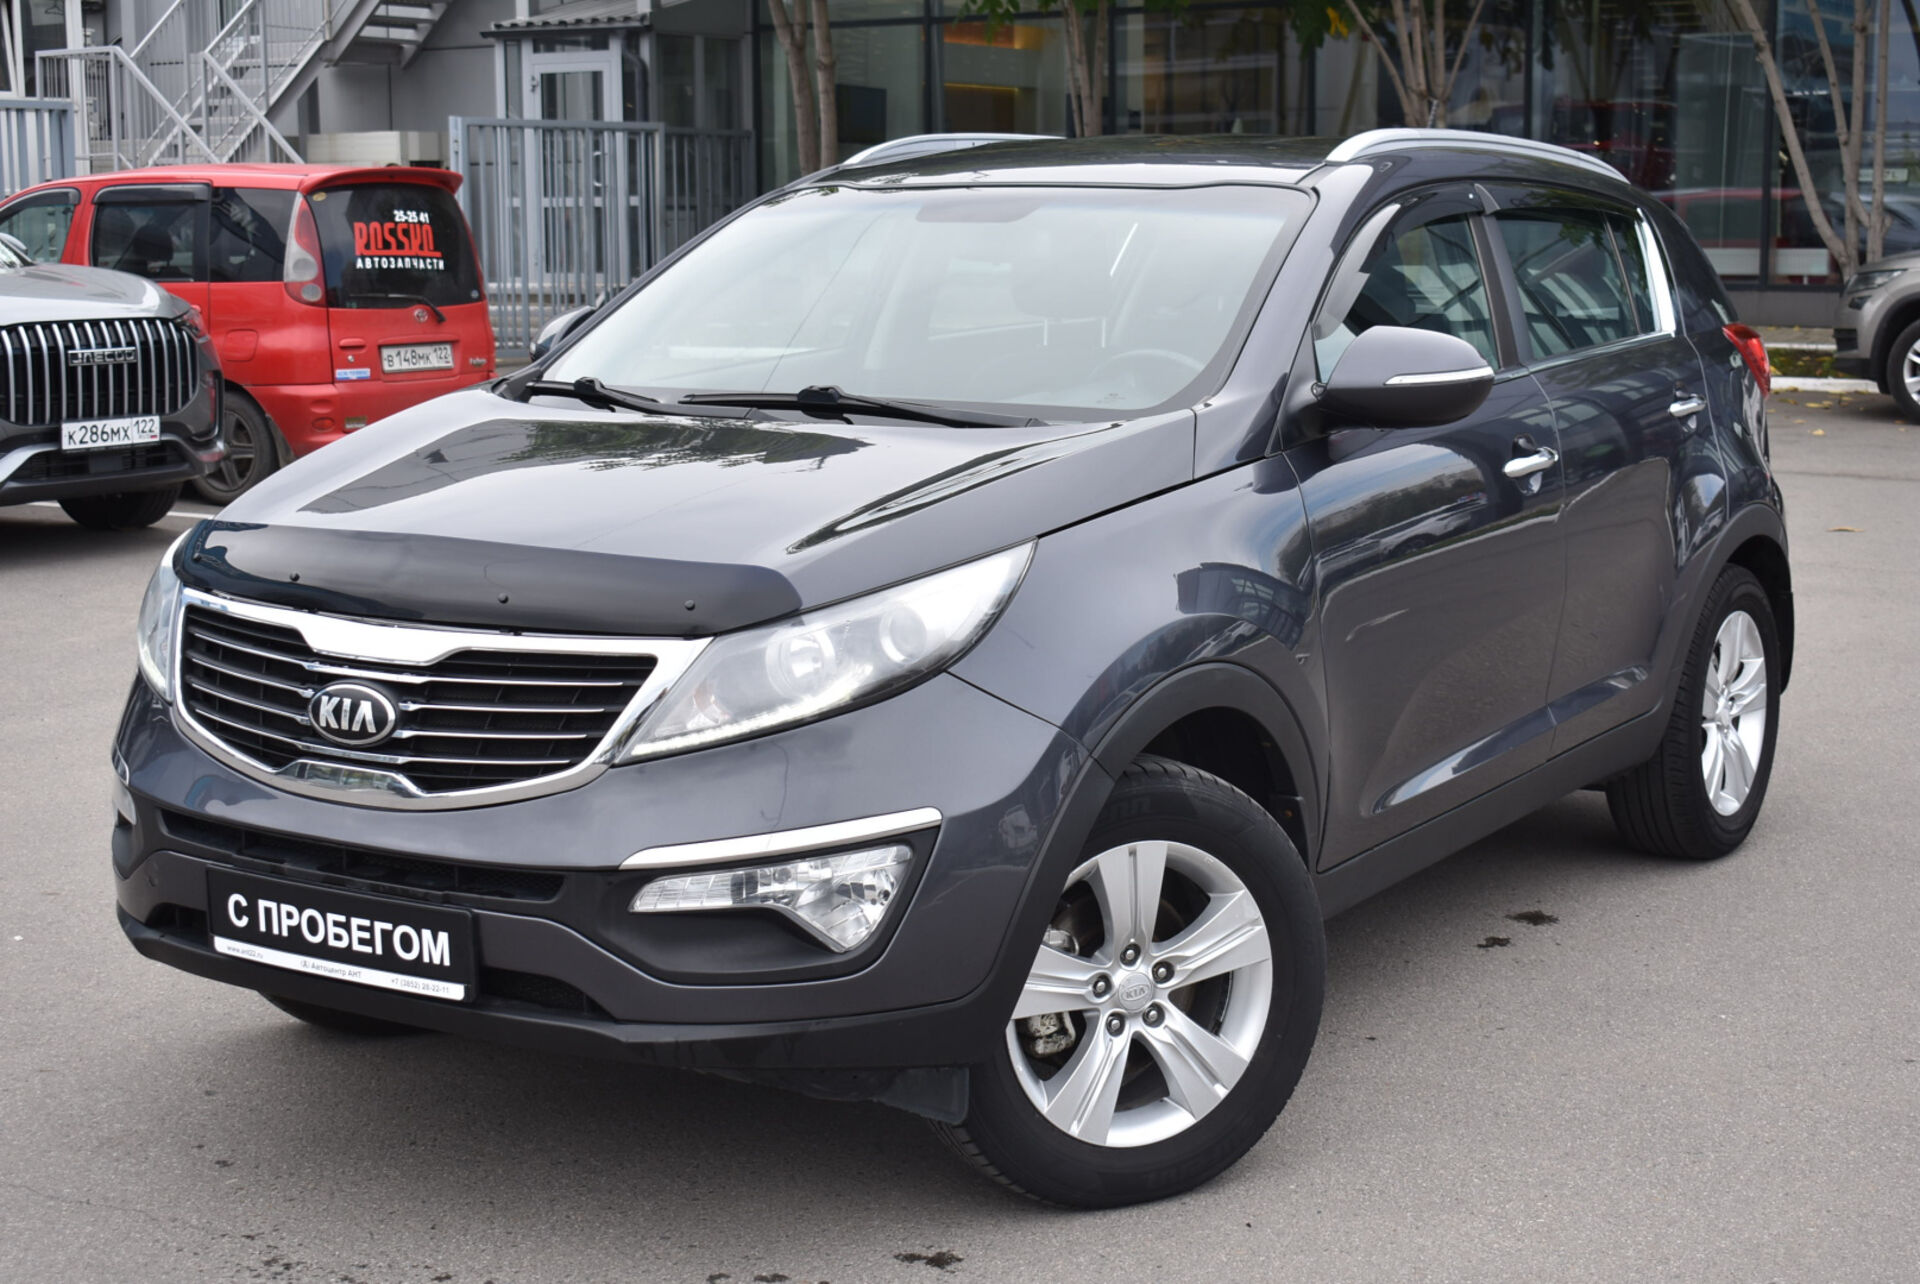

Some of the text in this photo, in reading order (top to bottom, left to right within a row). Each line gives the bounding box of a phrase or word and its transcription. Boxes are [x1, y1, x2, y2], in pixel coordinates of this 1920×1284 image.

[354, 222, 442, 257] ROSSKO
[356, 257, 445, 270] АВТОЗАПЧАСТИ
[133, 418, 156, 434] 122
[319, 695, 377, 733] KIA
[227, 893, 451, 967] С ПРОБЕГОМ
[311, 961, 347, 977] Автоцентр
[1126, 986, 1146, 999] KIA
